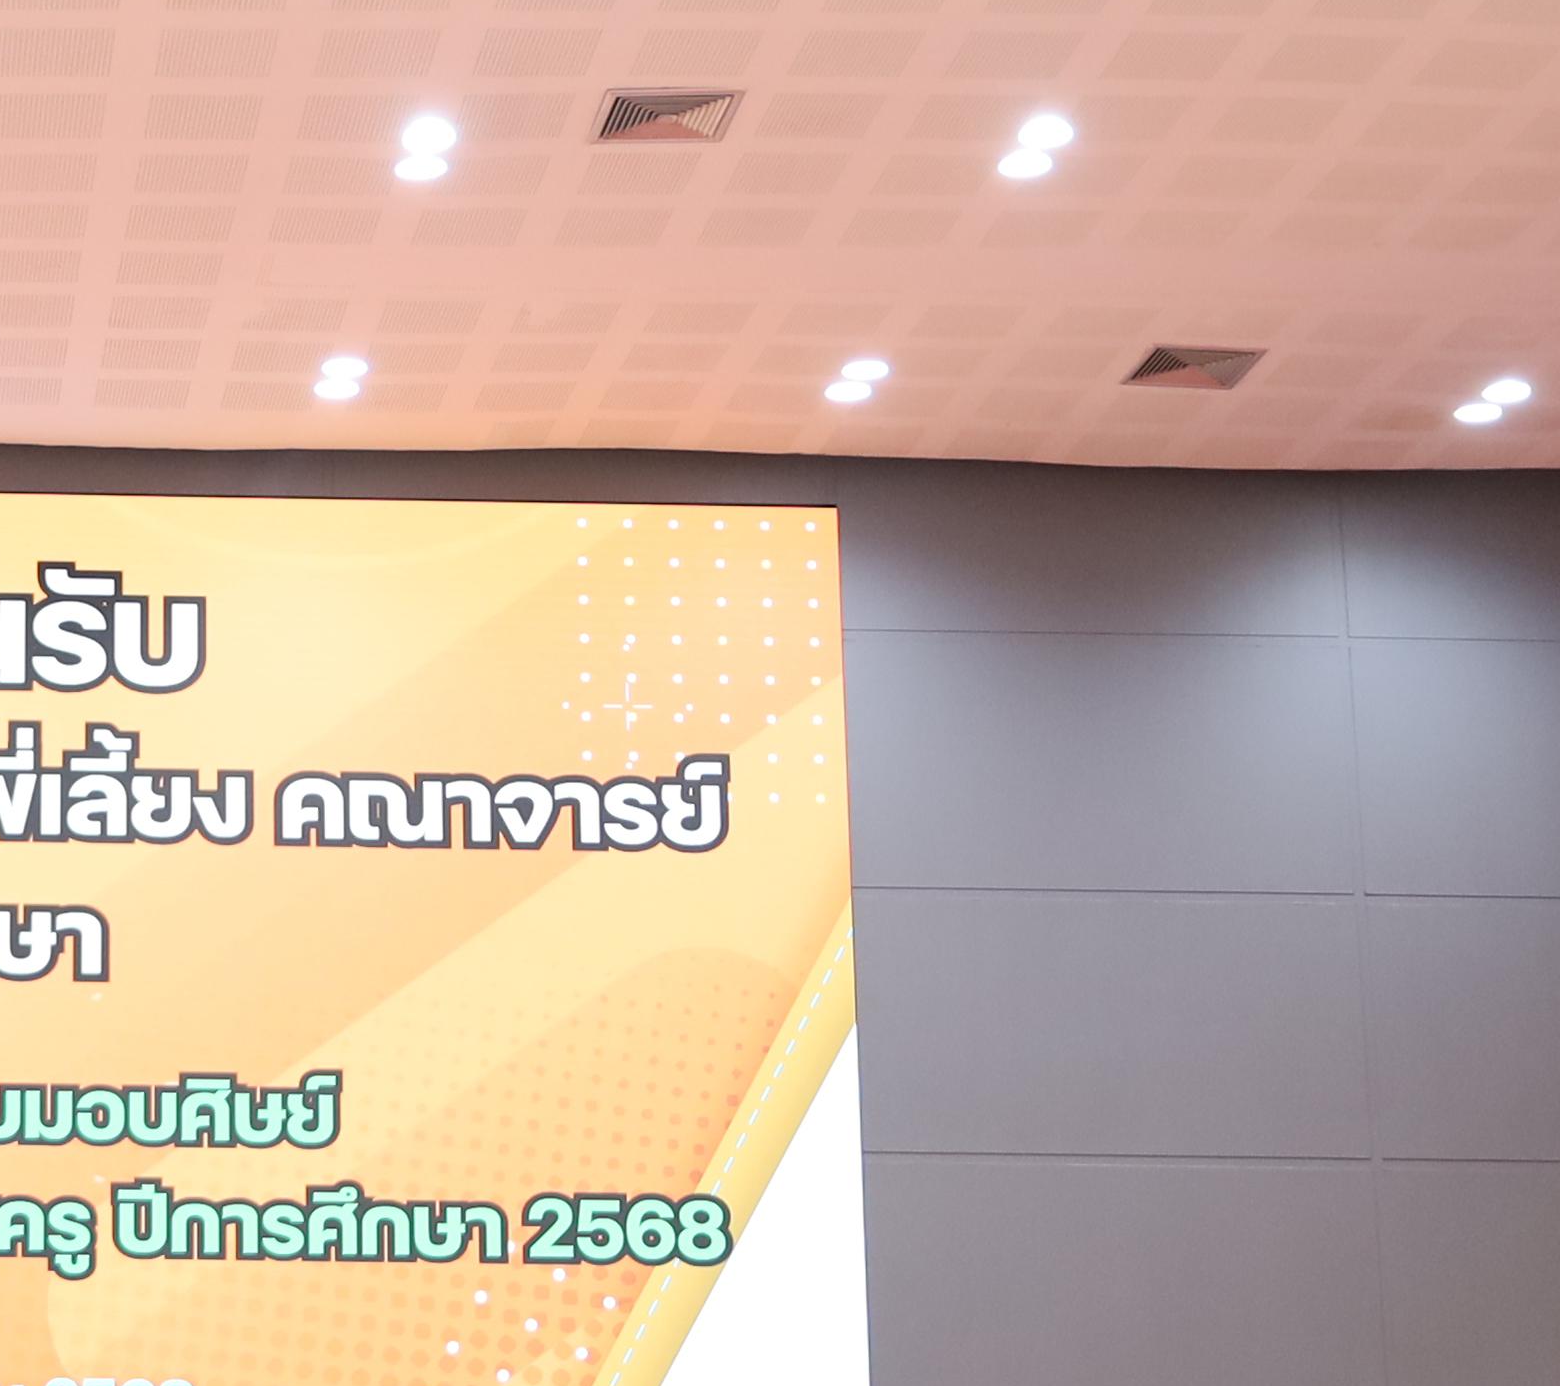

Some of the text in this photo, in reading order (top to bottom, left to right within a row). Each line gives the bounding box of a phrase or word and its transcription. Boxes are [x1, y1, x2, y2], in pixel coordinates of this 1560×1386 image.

[274, 754, 731, 852] คณาจารย์
[112, 1176, 507, 1263] ปีการศึกษา
[523, 1194, 733, 1265] 2568
